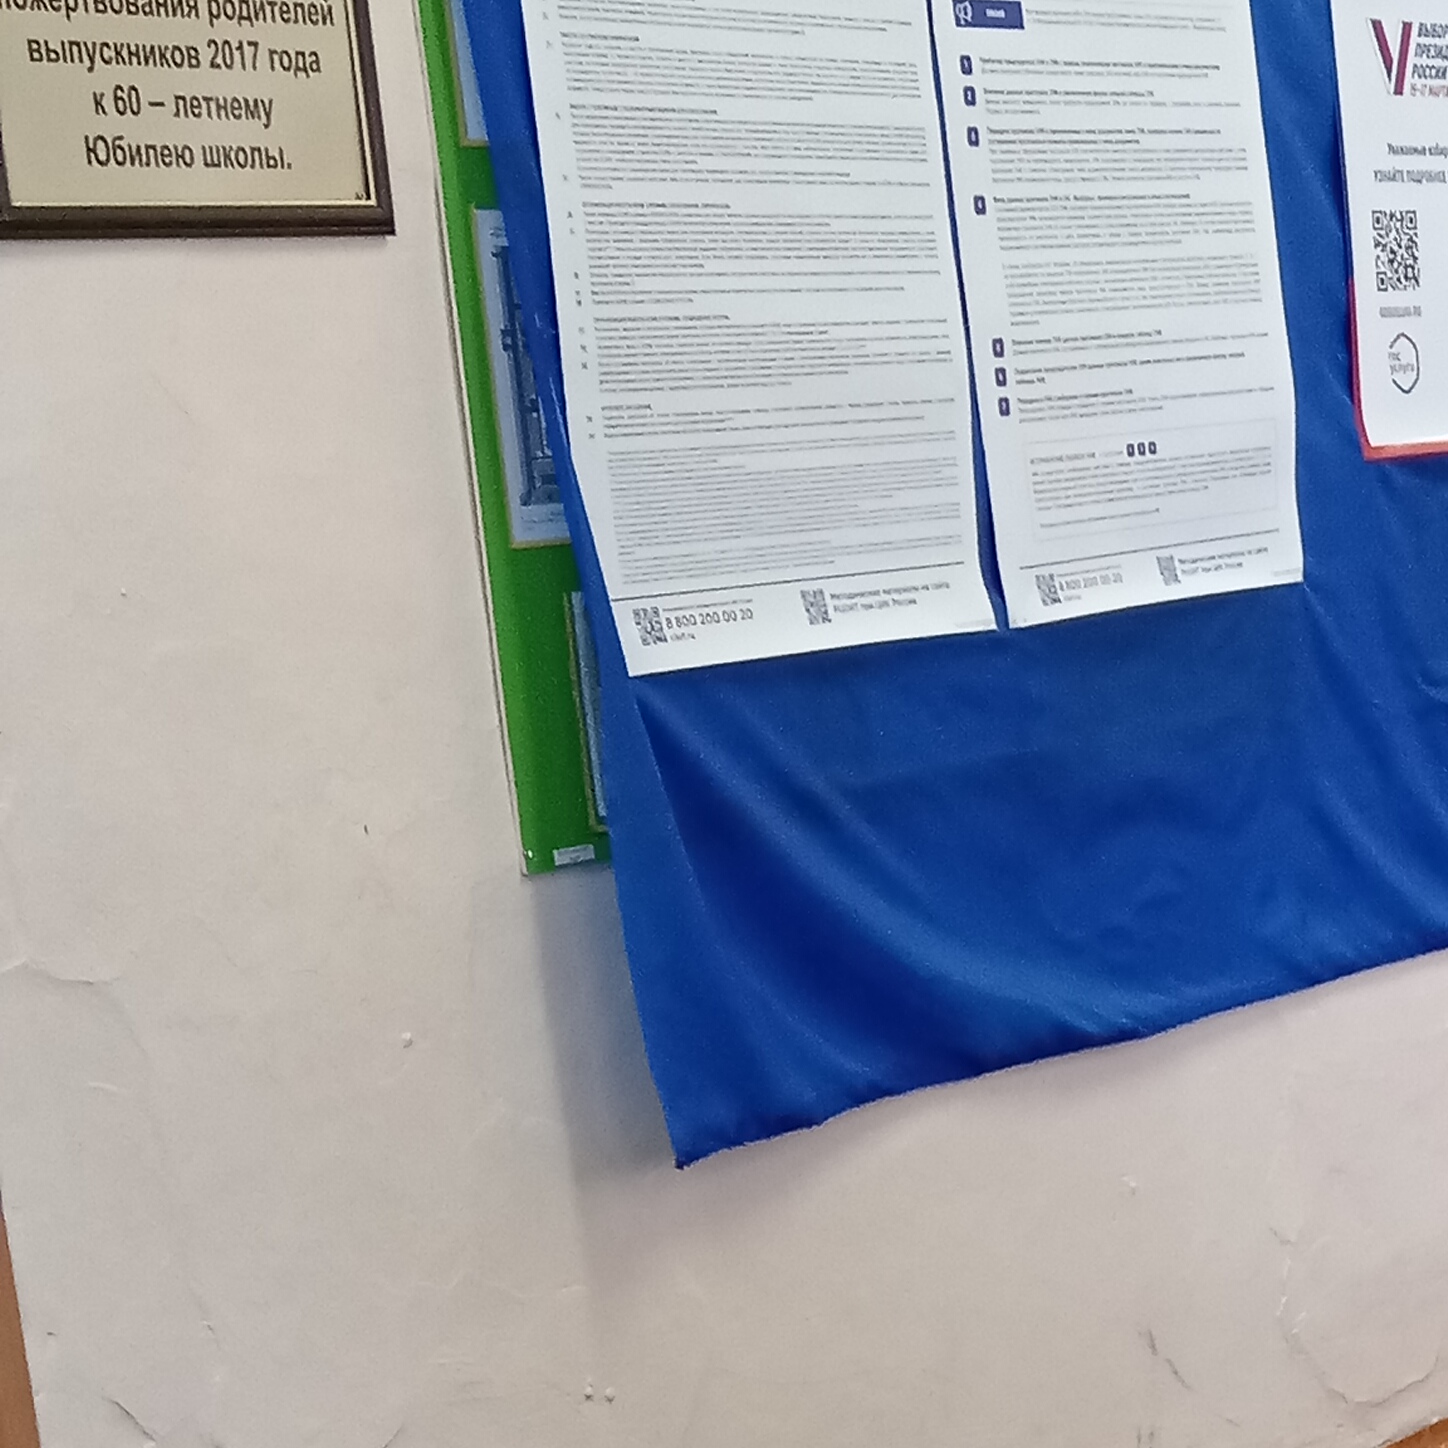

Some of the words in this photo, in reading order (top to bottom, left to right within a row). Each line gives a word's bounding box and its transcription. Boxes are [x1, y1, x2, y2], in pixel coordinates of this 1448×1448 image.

[27, 37, 202, 74] выпускников
[206, 38, 261, 73] 2017
[267, 45, 323, 80] года
[1411, 64, 1448, 81] РОССИИ
[93, 91, 108, 117] к
[112, 83, 142, 118] 60
[172, 92, 275, 130] летнему
[84, 132, 196, 171] Юбилею
[201, 143, 294, 172] школы.
